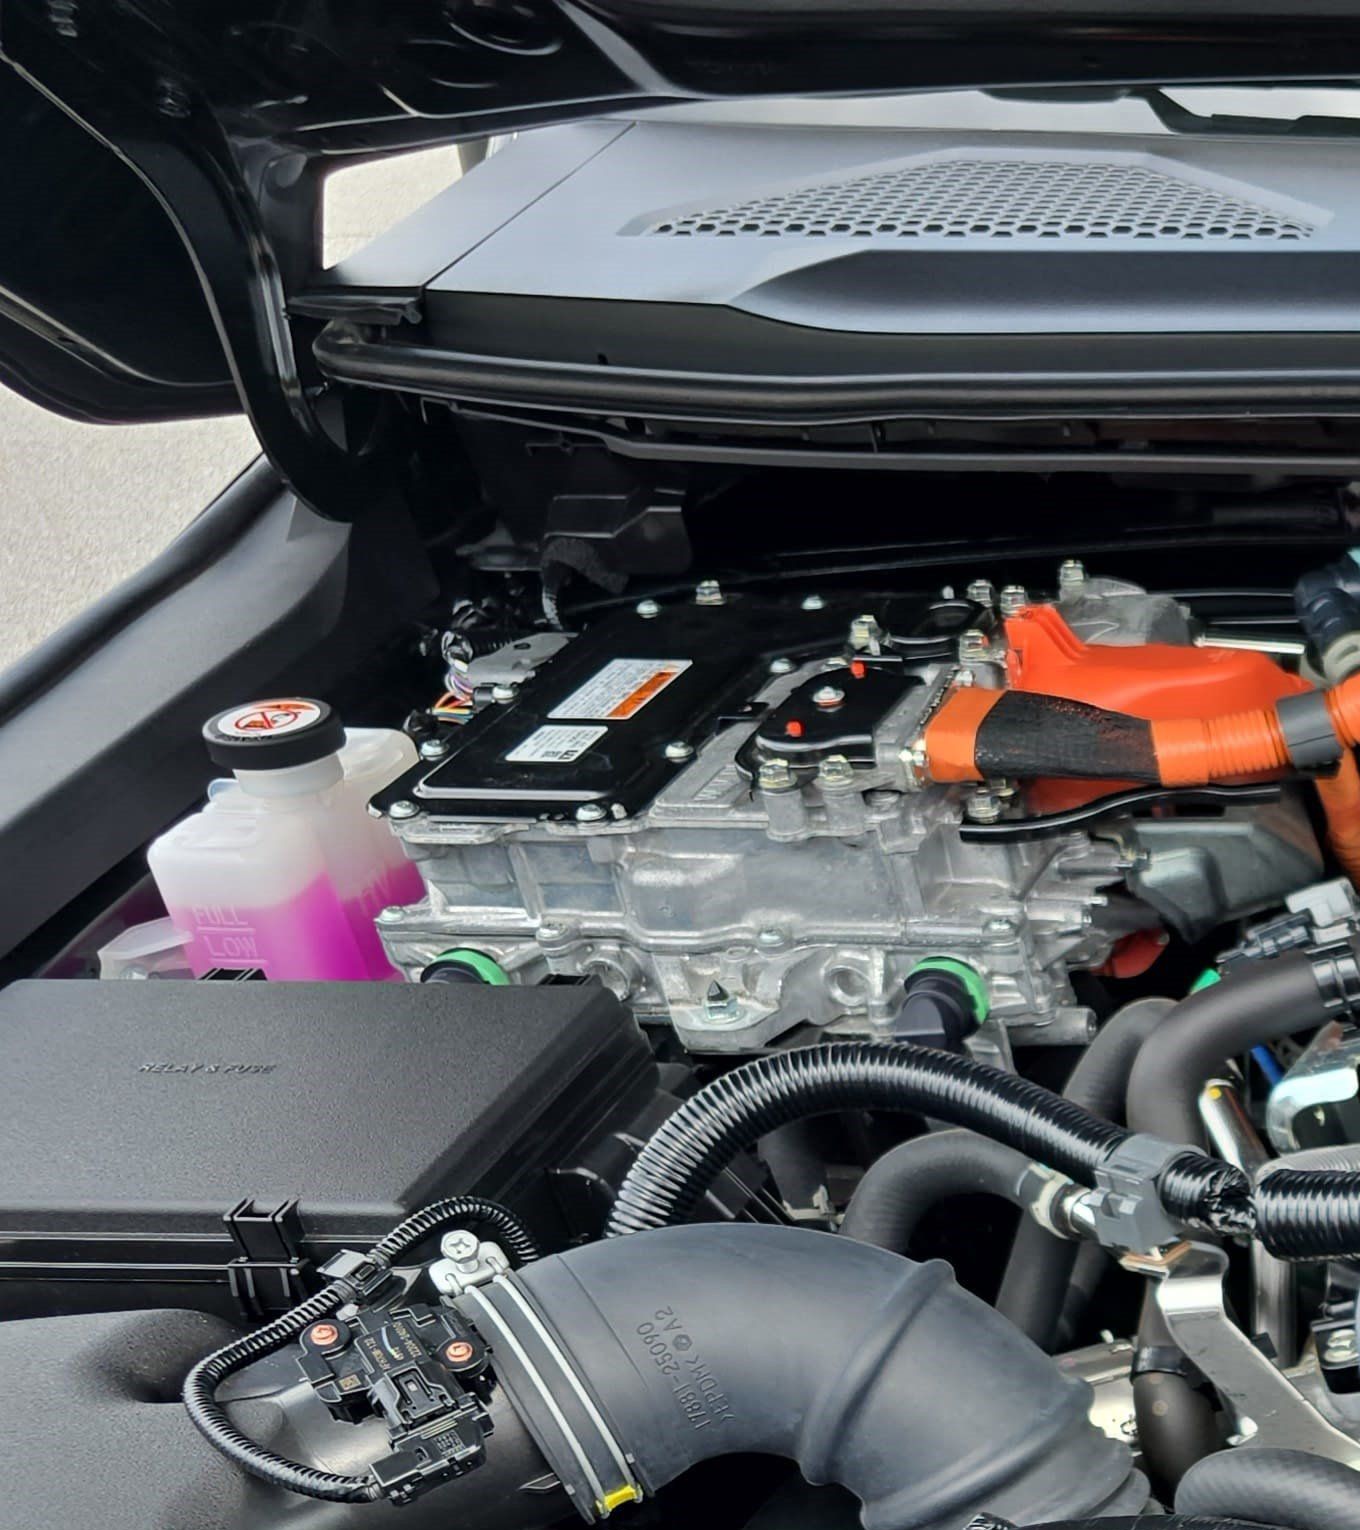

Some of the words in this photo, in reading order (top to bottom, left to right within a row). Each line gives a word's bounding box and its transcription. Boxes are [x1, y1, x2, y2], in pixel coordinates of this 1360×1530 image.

[192, 904, 249, 926] FULL
[204, 936, 259, 958] LOW
[636, 1321, 712, 1431] 17881-25090
